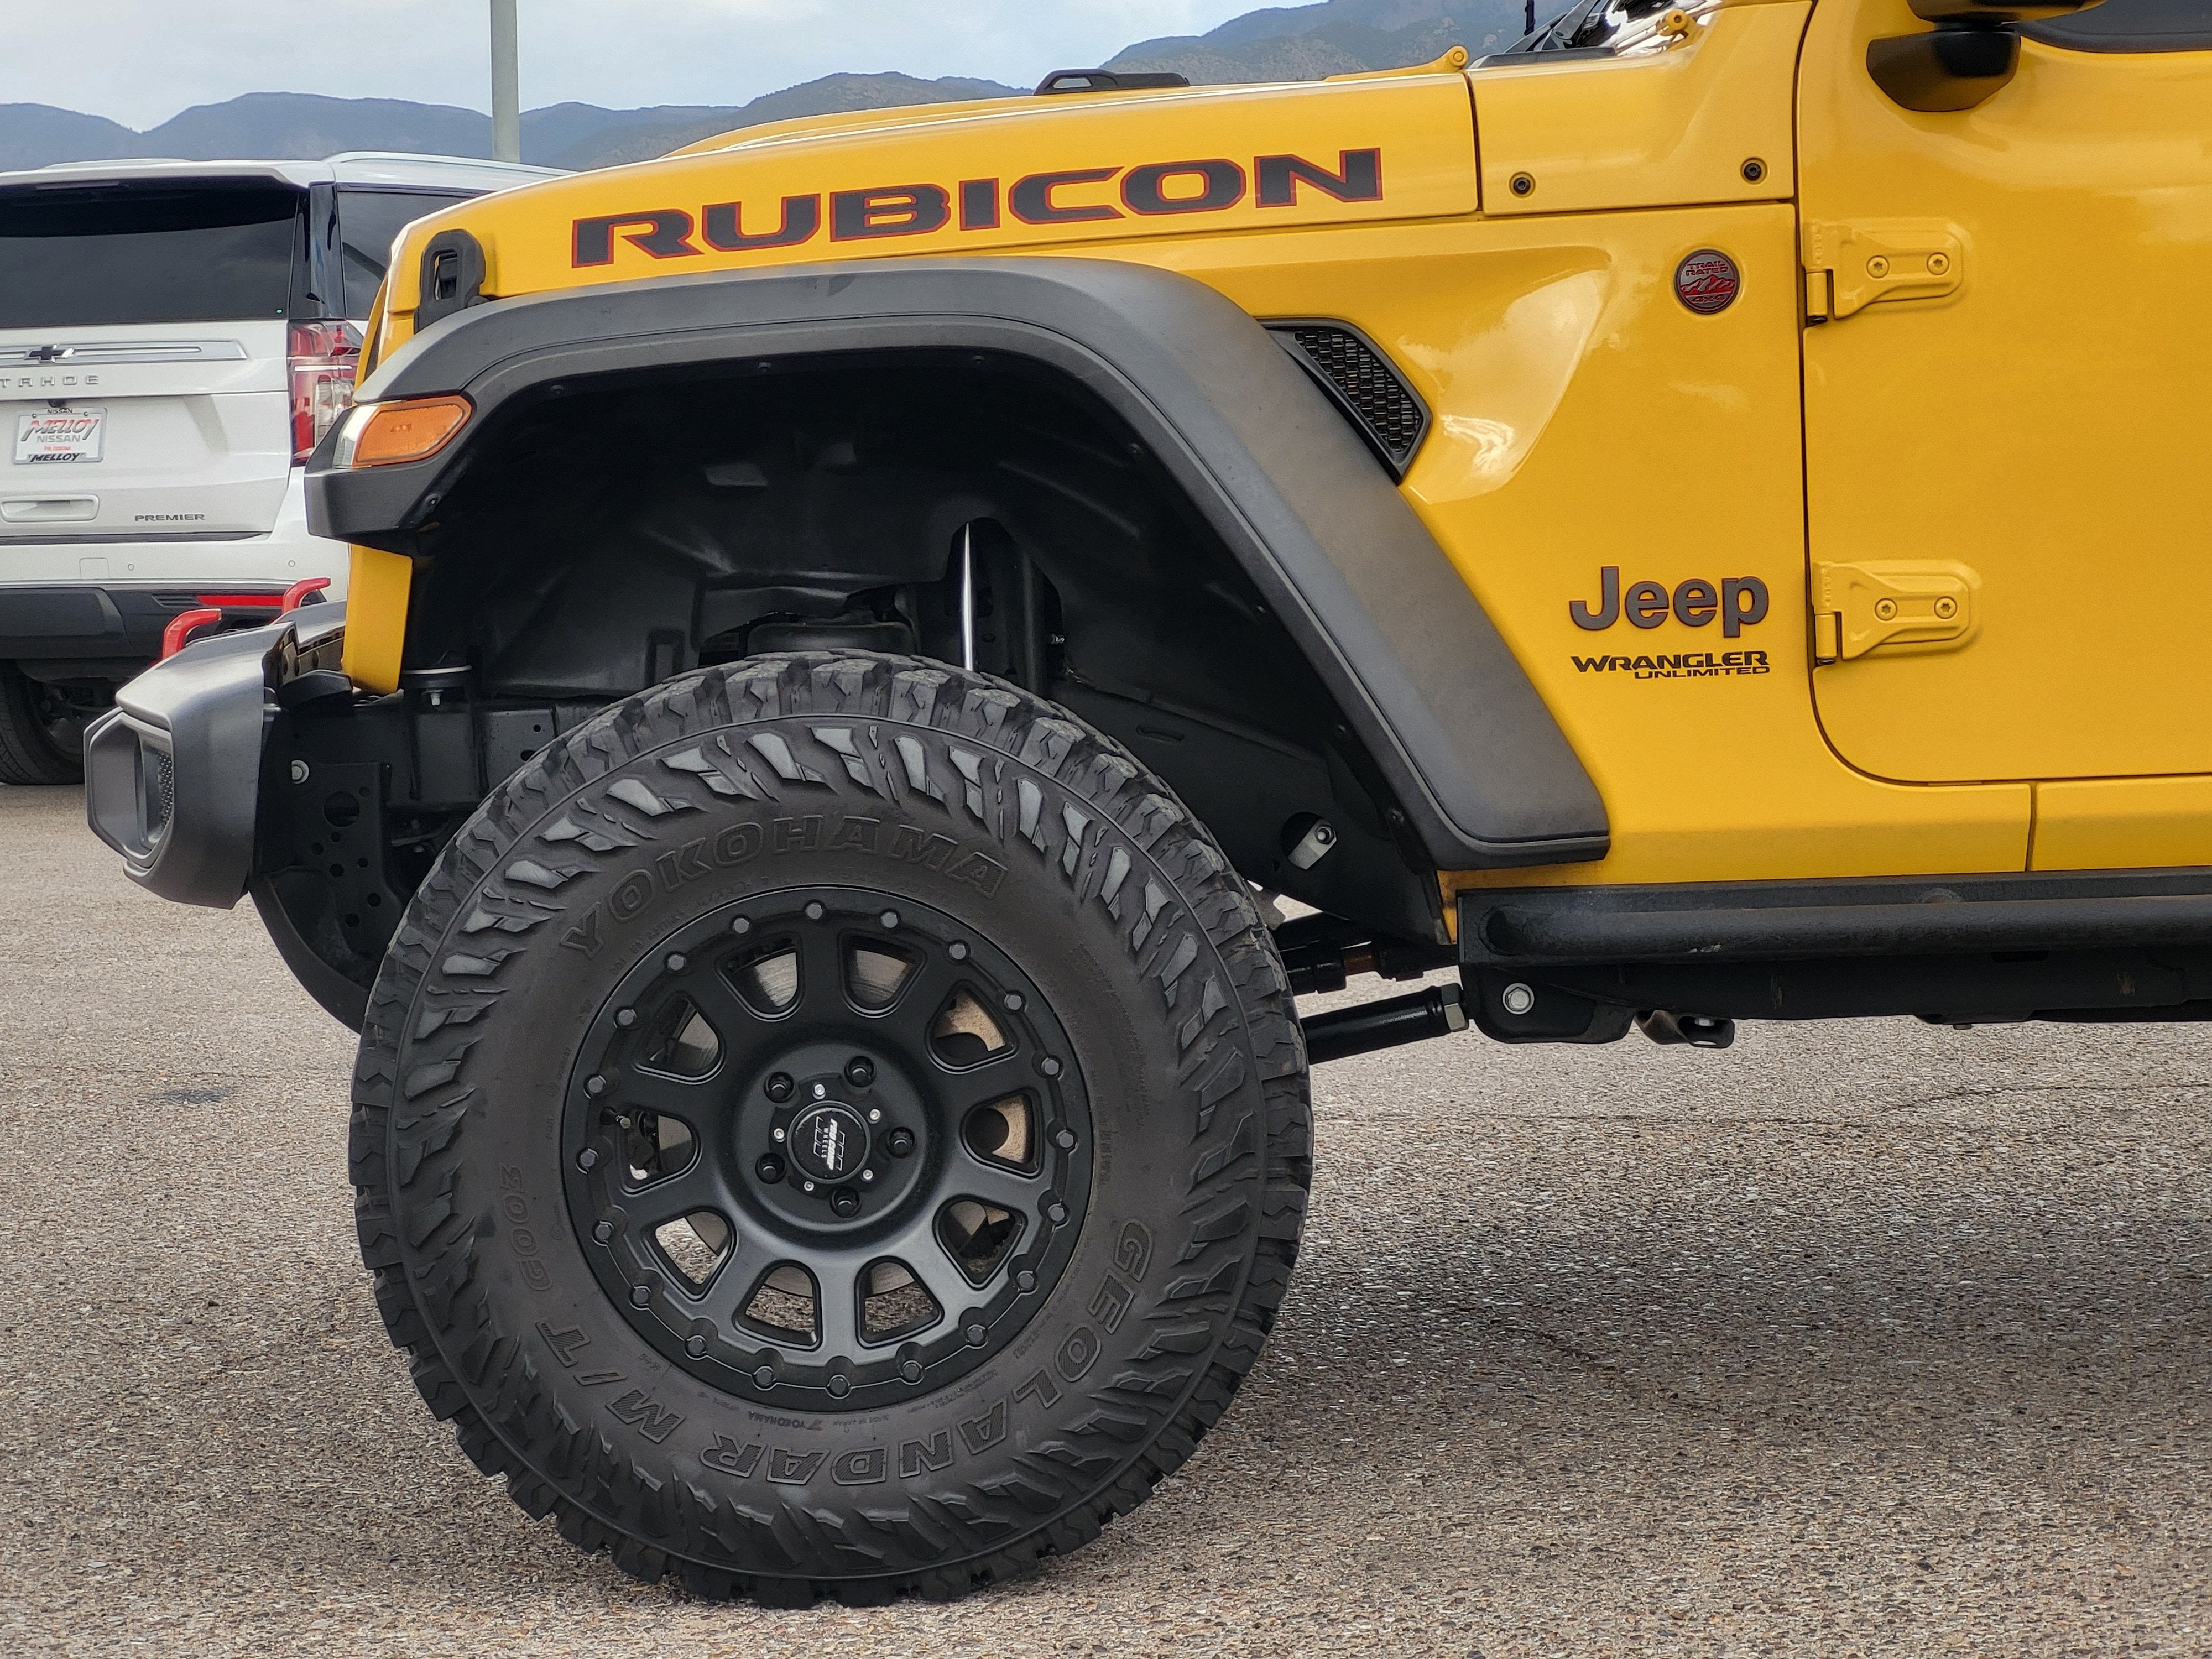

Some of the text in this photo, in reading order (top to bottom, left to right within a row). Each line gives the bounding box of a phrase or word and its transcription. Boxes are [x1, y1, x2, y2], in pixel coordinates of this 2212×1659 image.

[571, 148, 1383, 268] RUBICON
[1686, 267, 1728, 276] RATED
[1687, 261, 1725, 269] TRAIL
[0, 375, 99, 388] TAHOE
[30, 453, 80, 462] MELLOY
[1569, 565, 1770, 638] Jeep
[1569, 650, 1768, 673] WRANGLER
[1634, 666, 1770, 679] UNLIMITED
[560, 815, 1008, 958] YOKOHAMA
[698, 1218, 1154, 1485] GEOLANDAR
[535, 1320, 686, 1443] M/T
